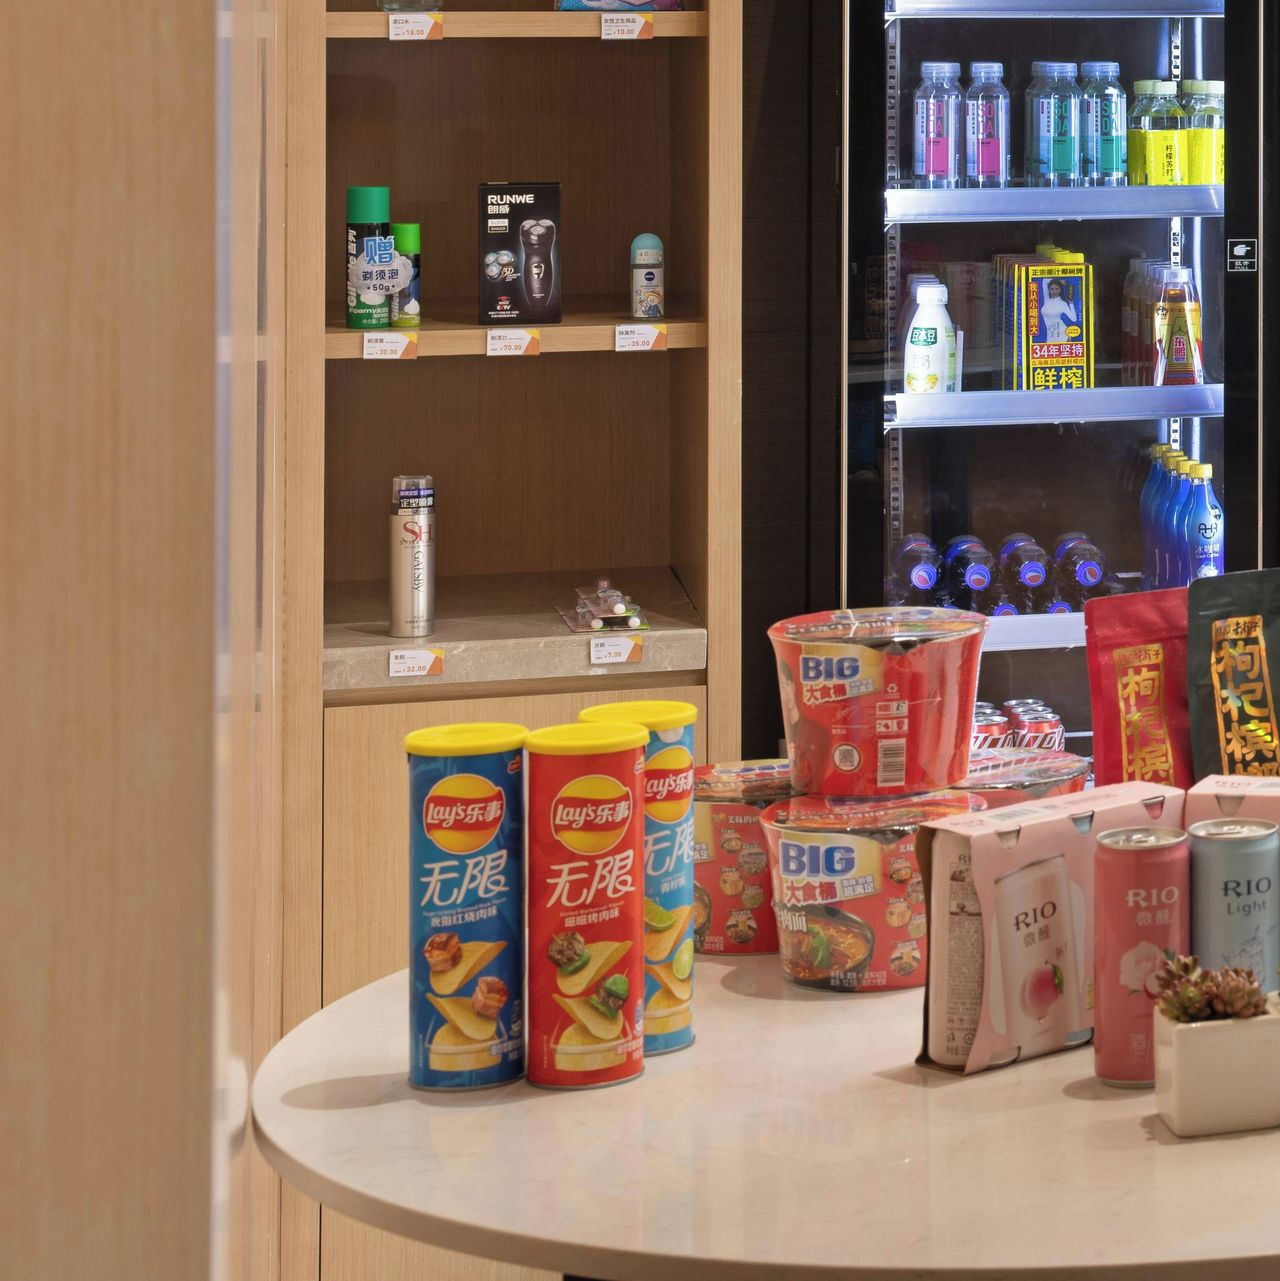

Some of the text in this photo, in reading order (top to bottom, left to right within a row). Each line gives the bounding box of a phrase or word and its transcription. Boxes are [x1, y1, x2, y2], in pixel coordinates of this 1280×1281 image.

[487, 194, 535, 205] RUNWE
[363, 235, 396, 266] 赠
[362, 268, 399, 282] 剃须泡
[1032, 343, 1084, 358] 34年坚持
[1033, 367, 1083, 390] 鲜榨
[800, 655, 861, 682] BIG
[1121, 666, 1171, 784] 枸杞槟
[779, 840, 856, 879] BIG
[419, 848, 511, 908] 无限
[545, 848, 637, 908] 无限
[1222, 876, 1272, 898] RIO
[785, 879, 838, 905] 大食桶
[1125, 886, 1180, 908] RIO
[1013, 900, 1058, 932] RIO
[1227, 899, 1267, 917] Light
